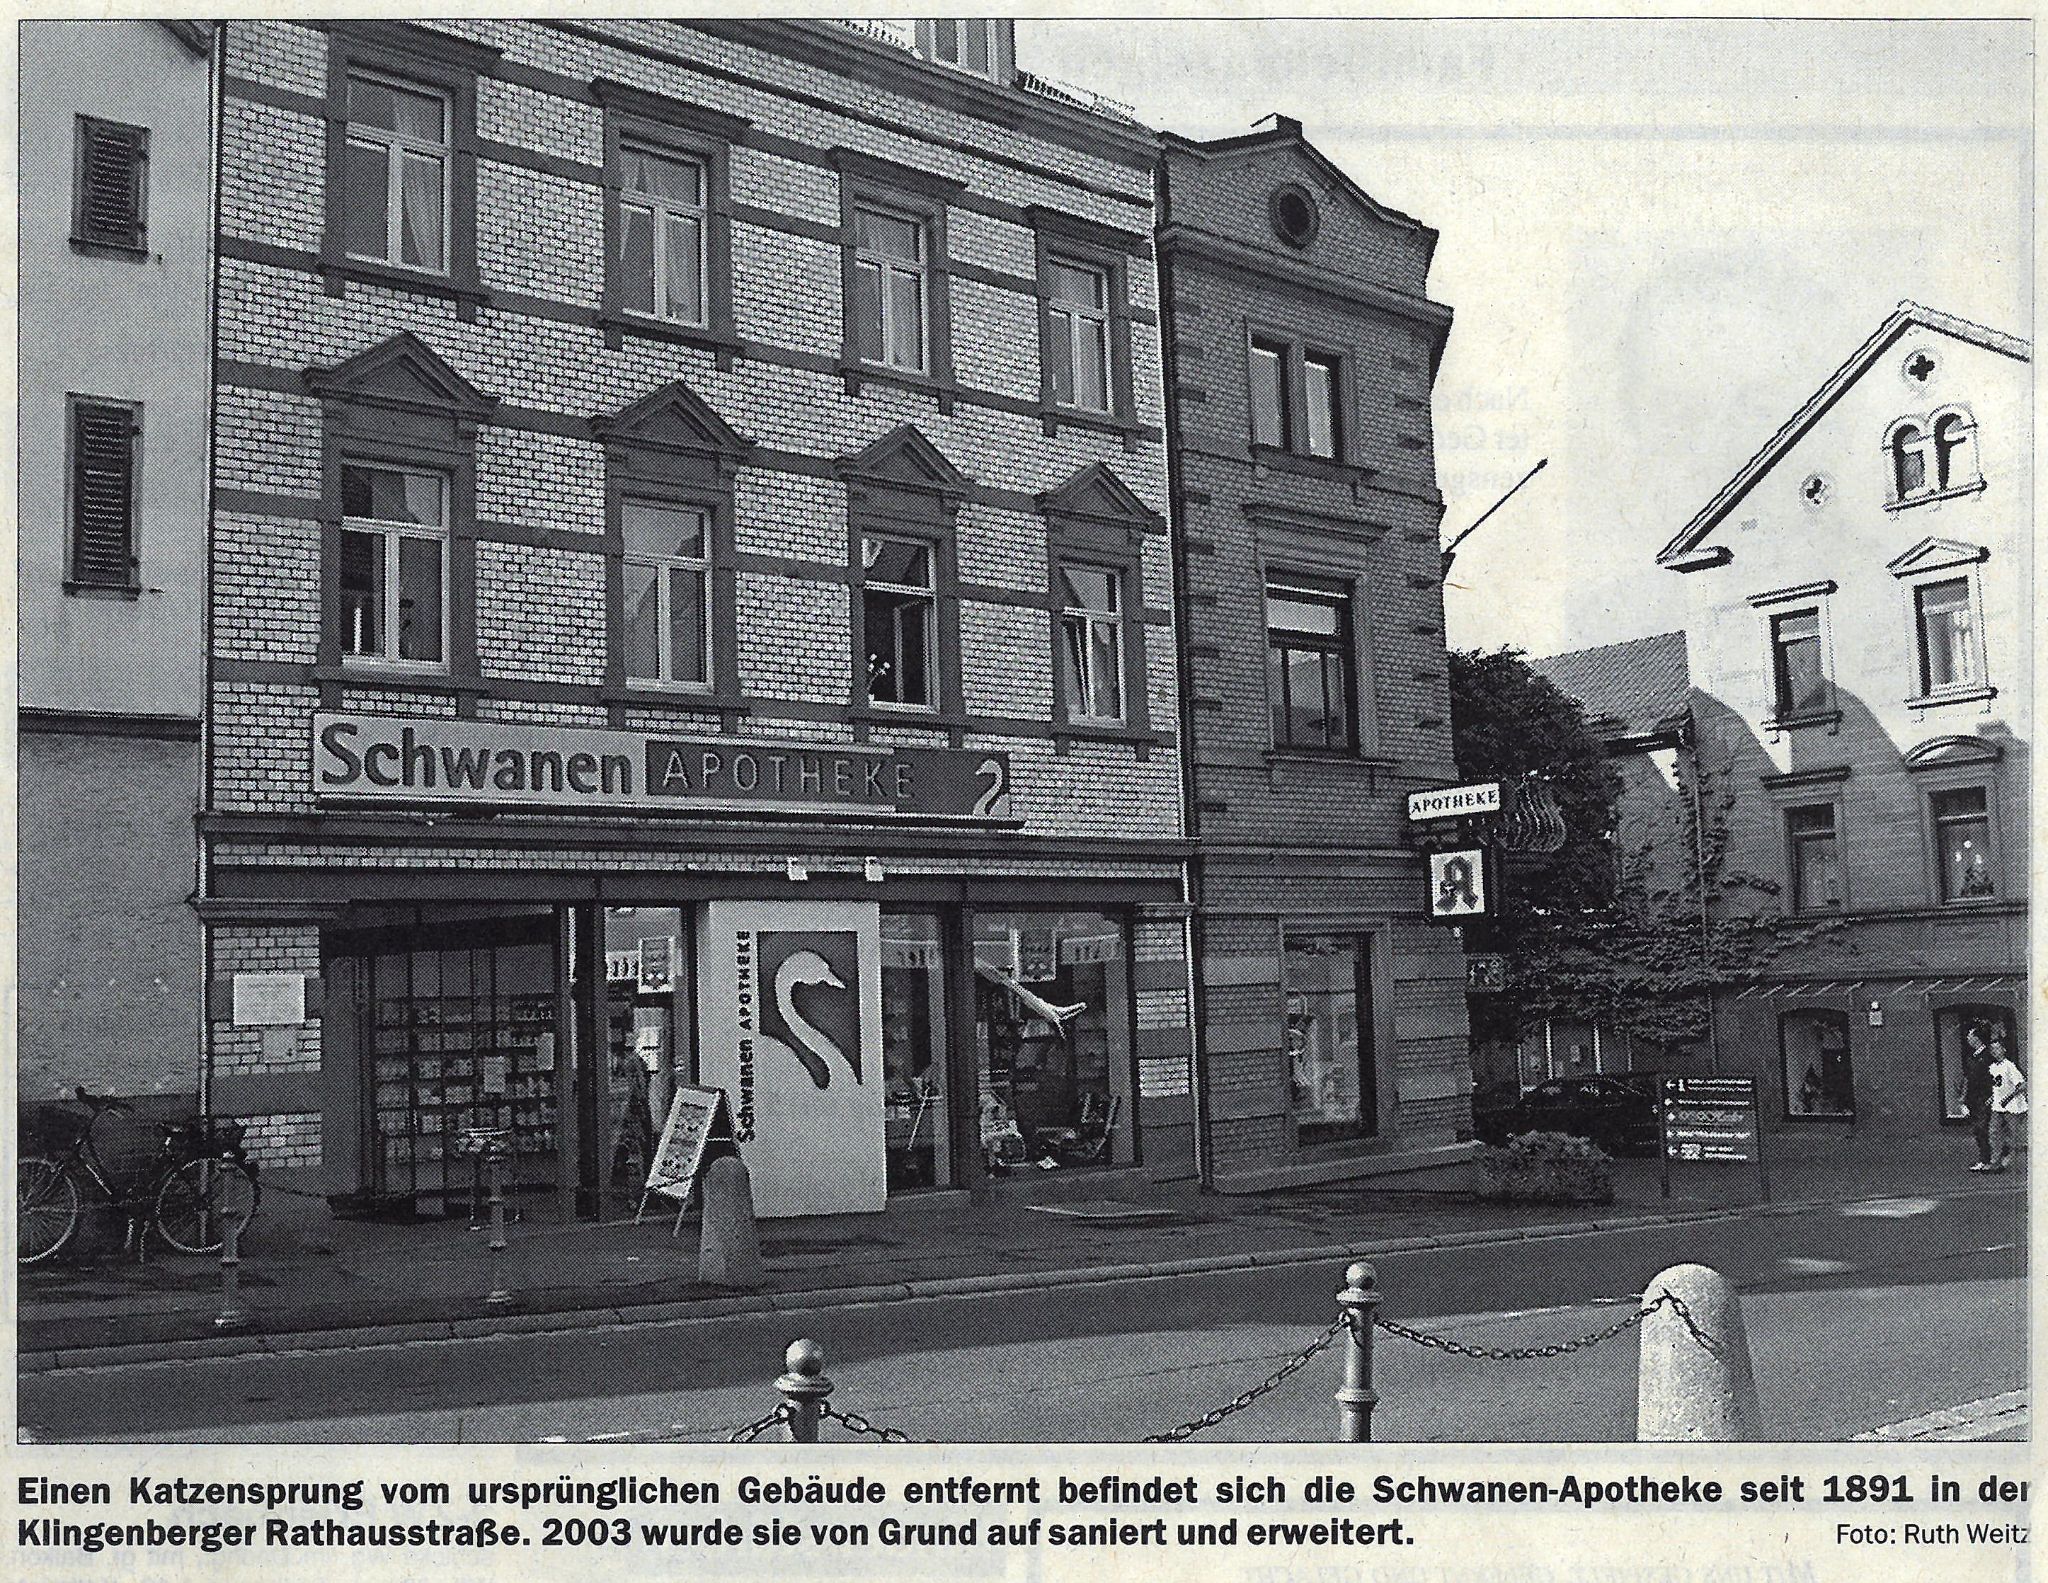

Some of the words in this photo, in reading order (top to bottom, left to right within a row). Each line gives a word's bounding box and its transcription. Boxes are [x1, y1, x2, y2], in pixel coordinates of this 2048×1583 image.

[320, 721, 632, 795] Schwanen
[661, 749, 916, 799] APOTHEKE
[1411, 789, 1498, 814] APOTHEKE
[736, 930, 752, 1031] APOTHEKE
[737, 1038, 755, 1143] Schwanen
